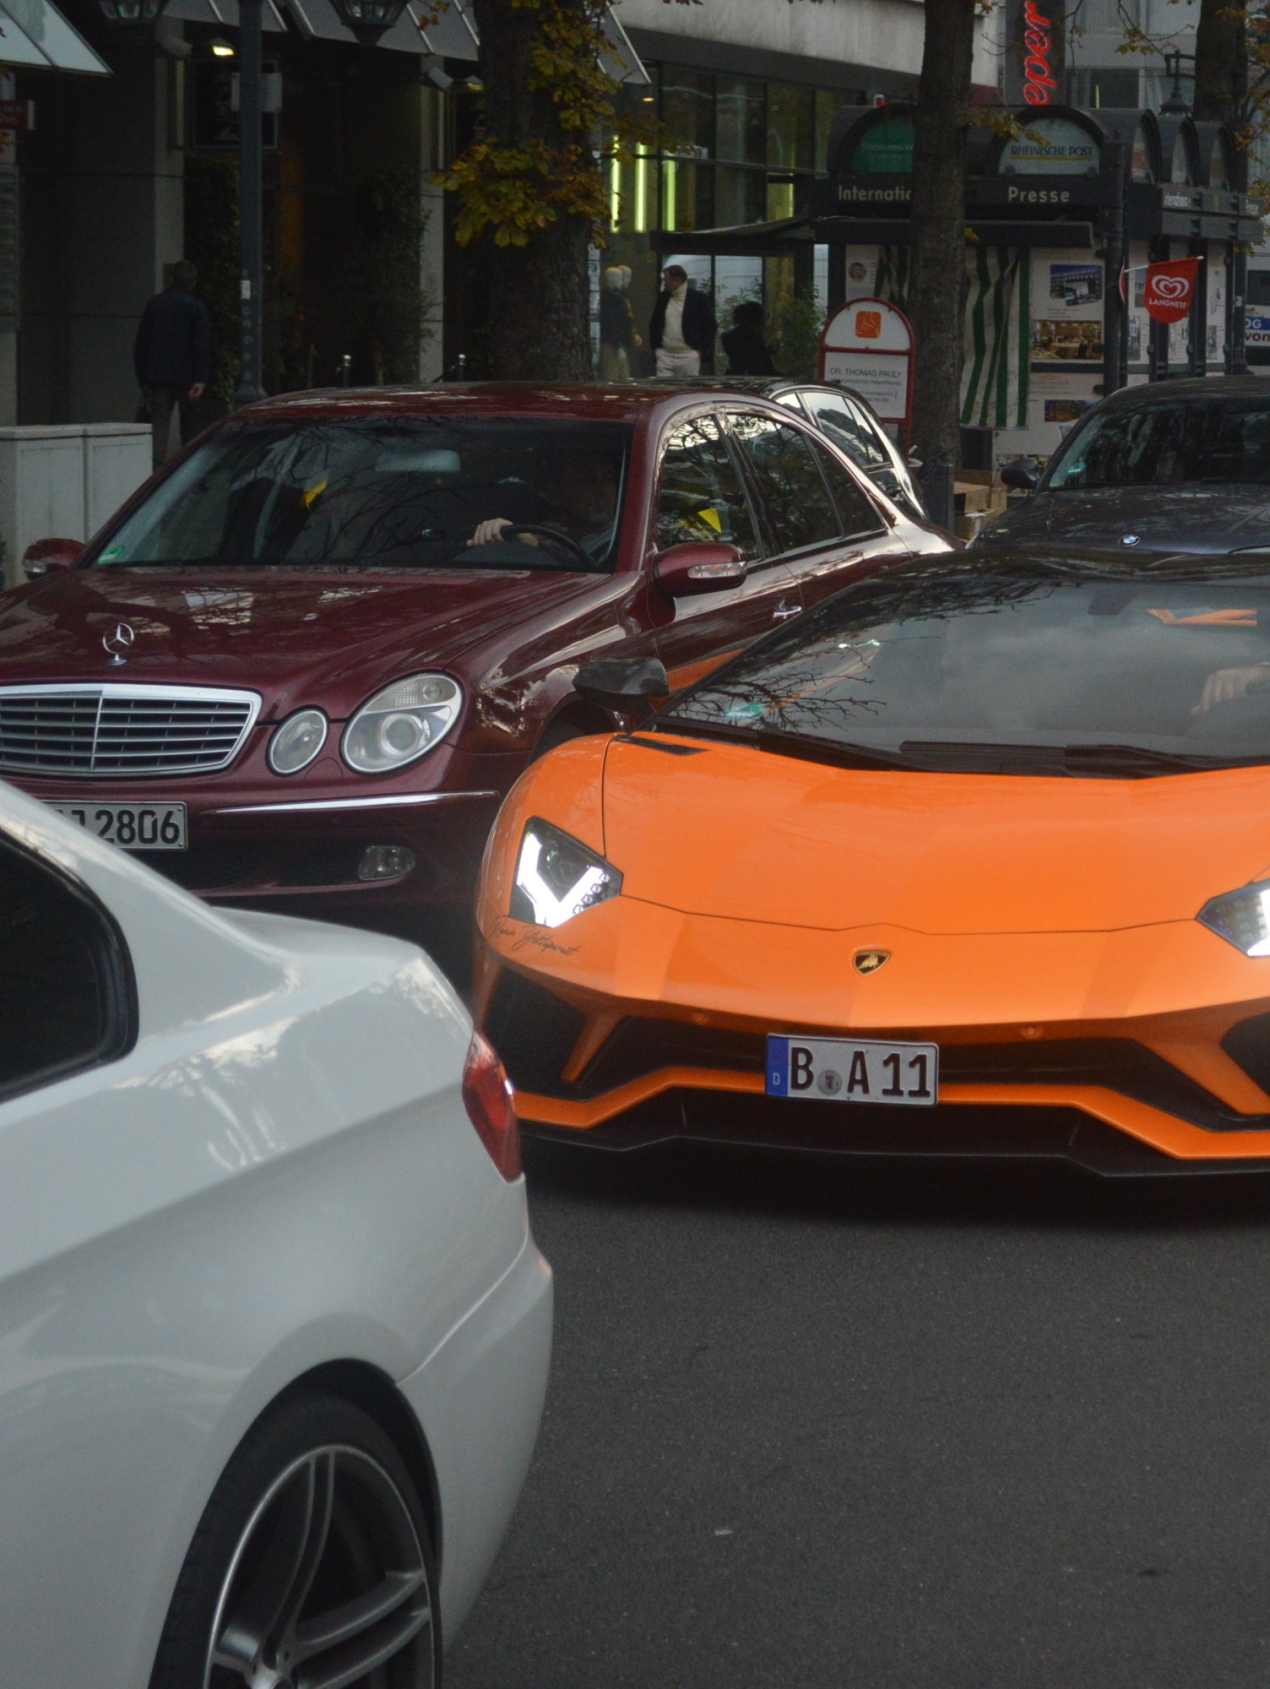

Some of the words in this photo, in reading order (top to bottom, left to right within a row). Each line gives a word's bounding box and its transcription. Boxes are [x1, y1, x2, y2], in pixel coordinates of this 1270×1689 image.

[1011, 145, 1066, 156] RHEINISCHE
[1069, 146, 1093, 157] POST
[1007, 186, 1071, 203] Presse
[1245, 332, 1270, 342] von
[830, 367, 841, 375] DR.
[845, 368, 877, 377] THOMAS
[879, 369, 902, 378] PAULY
[790, 1047, 815, 1090] B
[847, 1050, 870, 1094] A
[882, 1053, 931, 1097] 11
[772, 1072, 781, 1086] D
